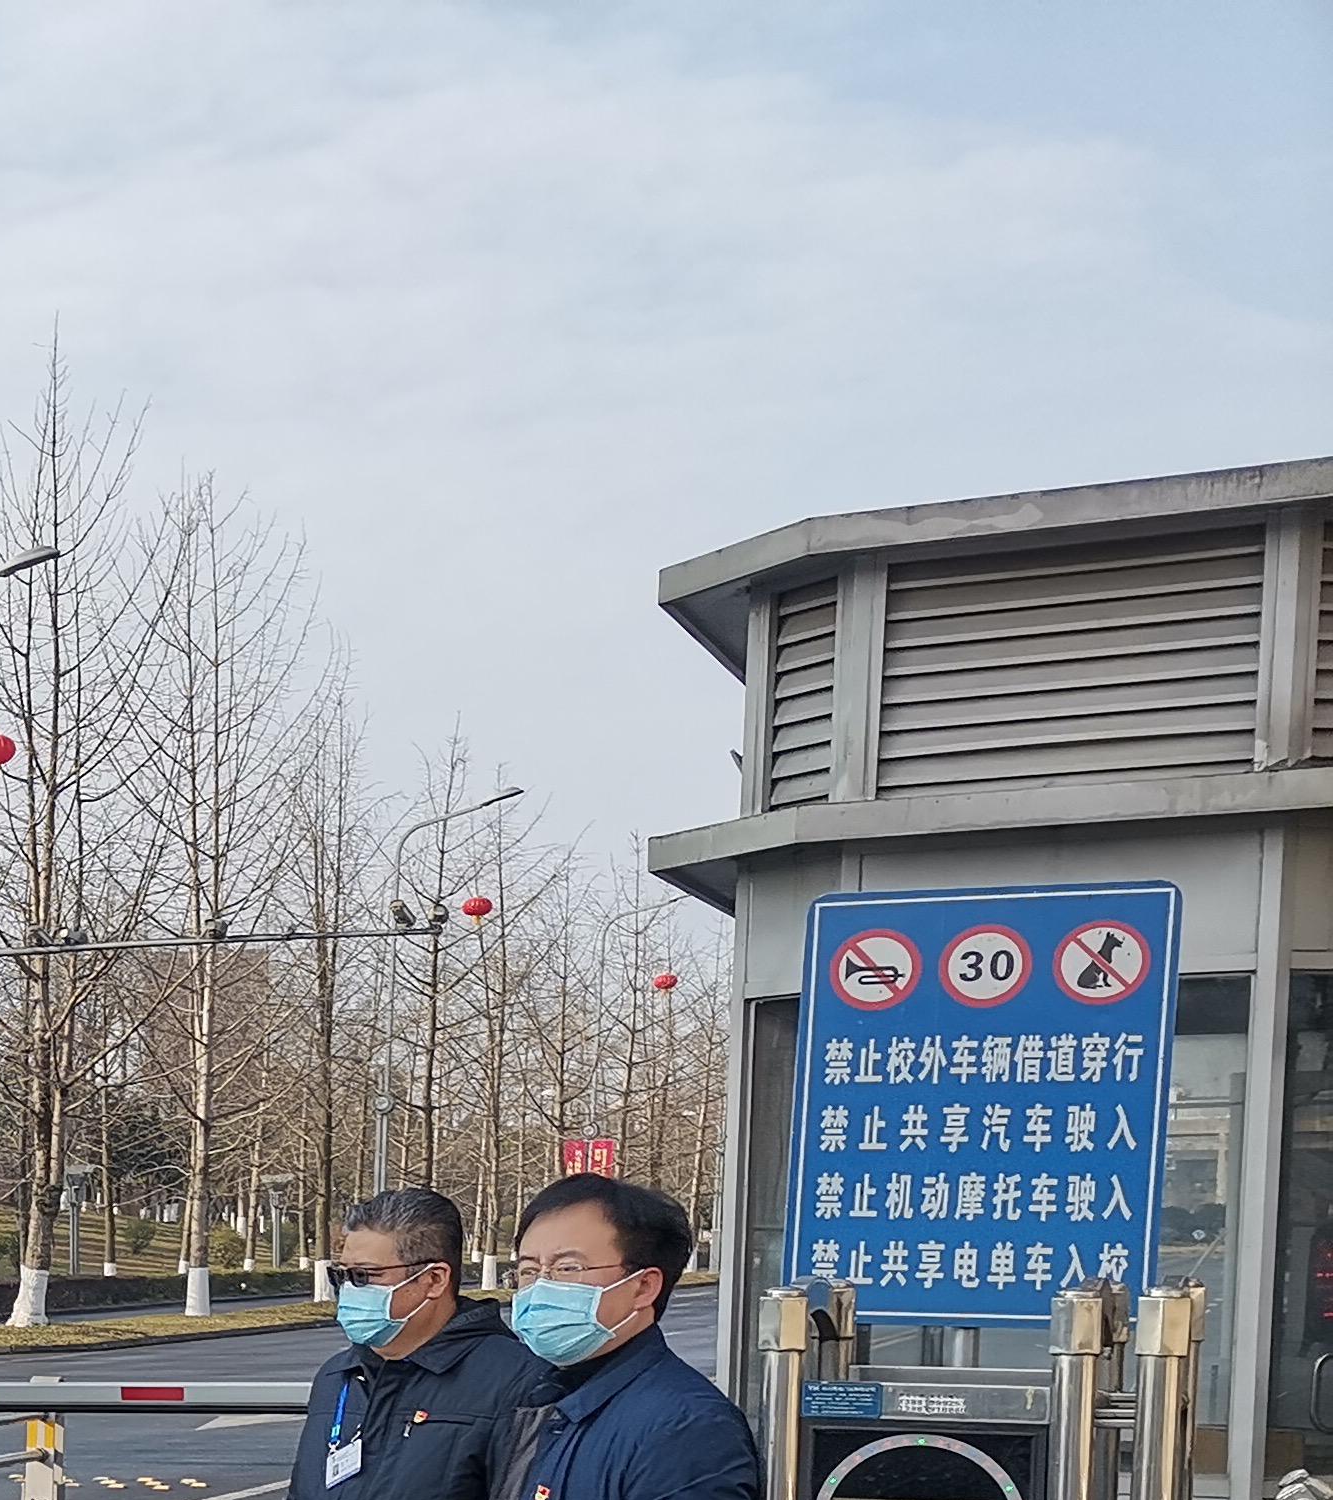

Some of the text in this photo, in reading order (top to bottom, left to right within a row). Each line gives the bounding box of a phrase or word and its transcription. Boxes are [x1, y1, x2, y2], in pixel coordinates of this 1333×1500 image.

[958, 949, 1015, 983] 30
[823, 1031, 1145, 1086] 禁止校外车辆借道穿行
[818, 1103, 1138, 1154] 禁止共享汽车驶入
[814, 1172, 1133, 1223] 禁止机动摩托车驶入
[811, 1239, 1130, 1290] 禁止共享电单车入校
